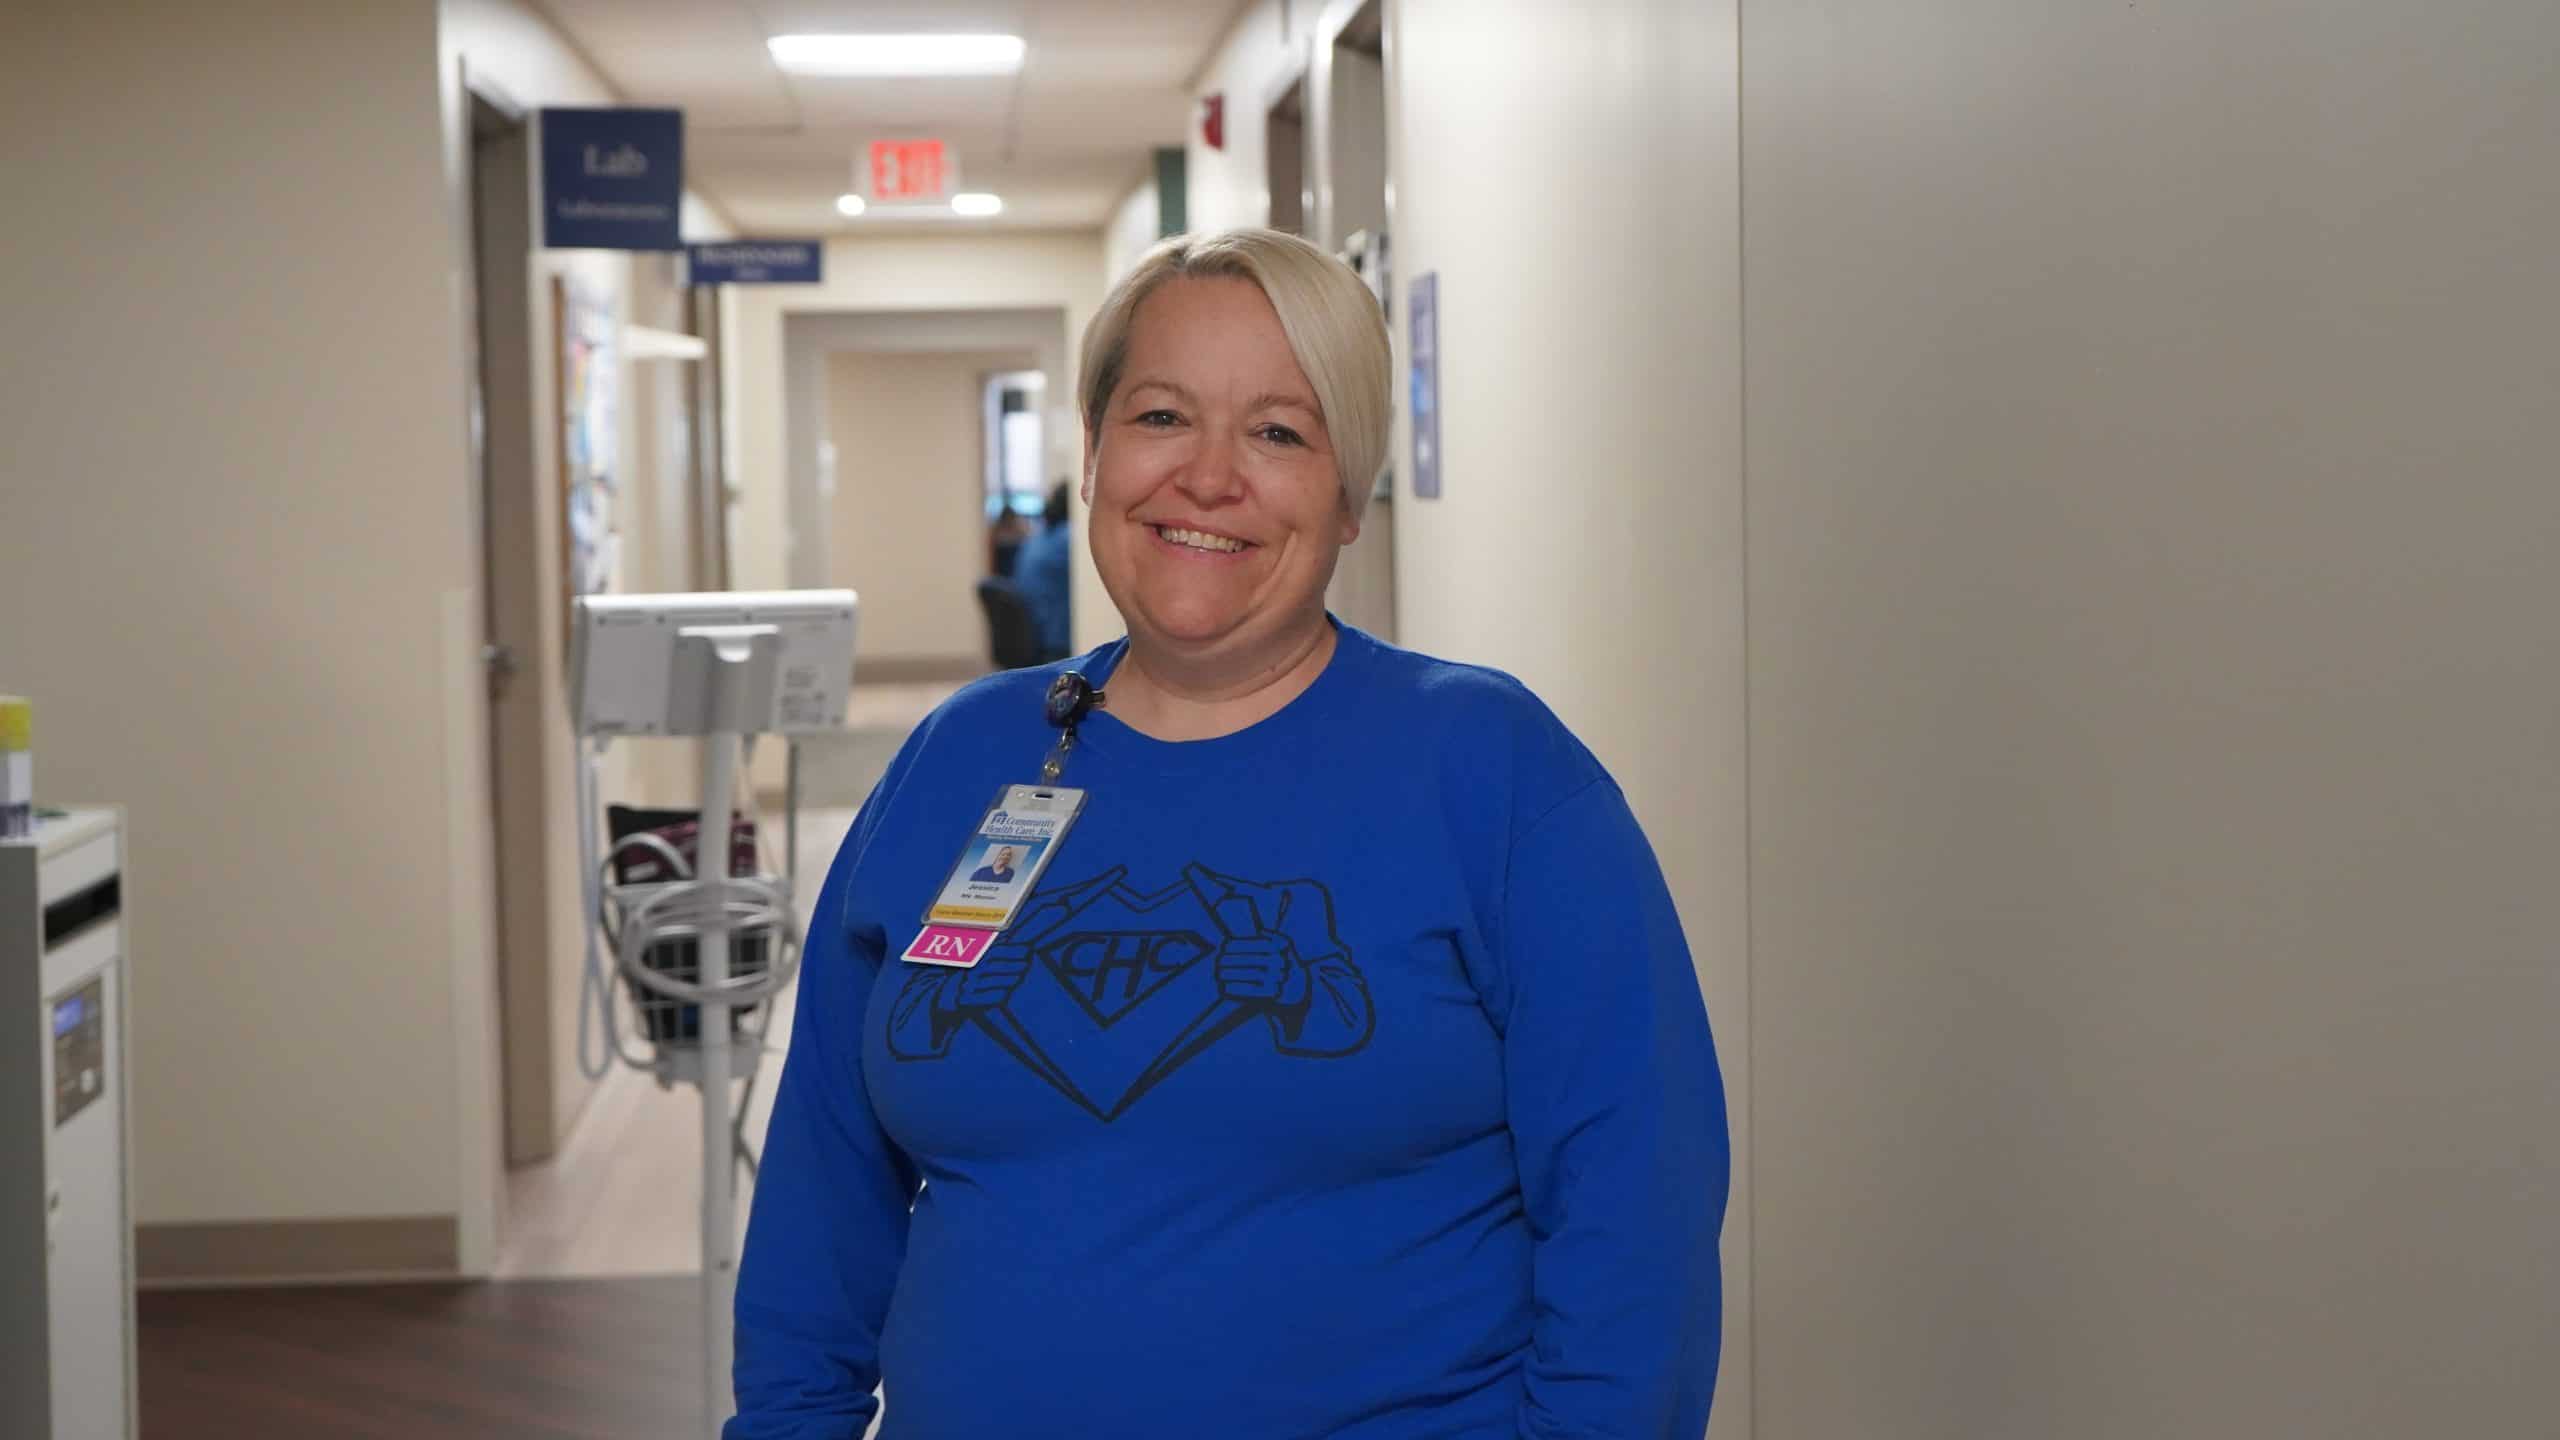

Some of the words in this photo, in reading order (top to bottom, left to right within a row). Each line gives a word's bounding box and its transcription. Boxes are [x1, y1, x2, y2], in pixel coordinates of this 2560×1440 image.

[583, 145, 647, 176] Lab
[870, 140, 944, 198] EXIT
[985, 824, 1013, 835] Health
[923, 934, 976, 958] RN
[1060, 935, 1189, 1001] CHC
